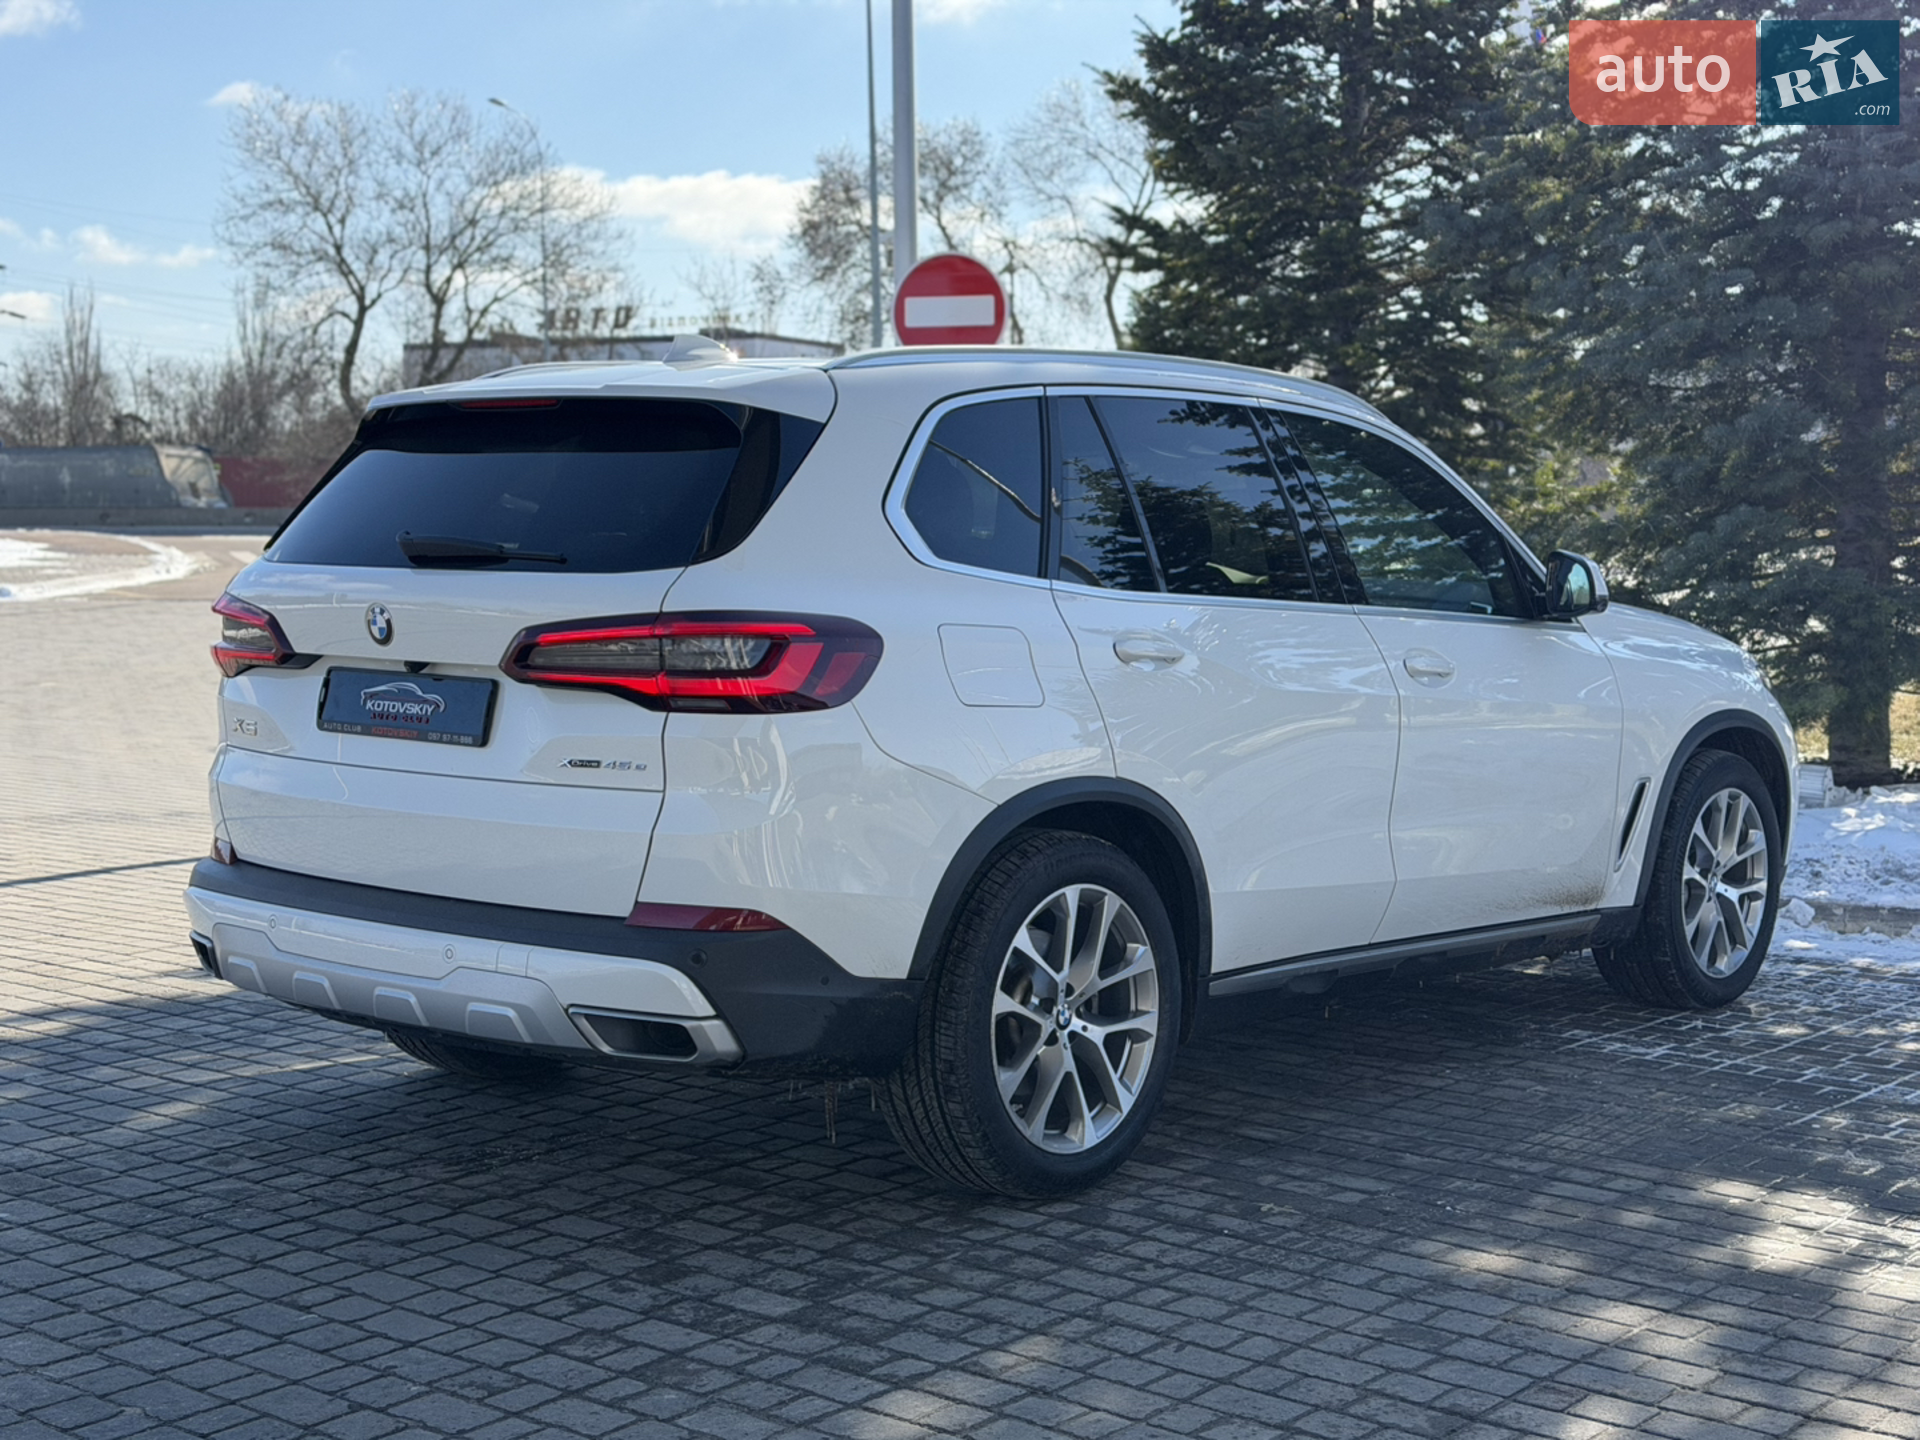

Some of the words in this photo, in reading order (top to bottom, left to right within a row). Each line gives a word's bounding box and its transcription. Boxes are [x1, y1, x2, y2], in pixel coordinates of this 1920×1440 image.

[366, 699, 435, 716] KOTOVSKIY
[233, 717, 258, 737] X5
[323, 722, 342, 731] AUTO
[343, 723, 362, 733] CLUB
